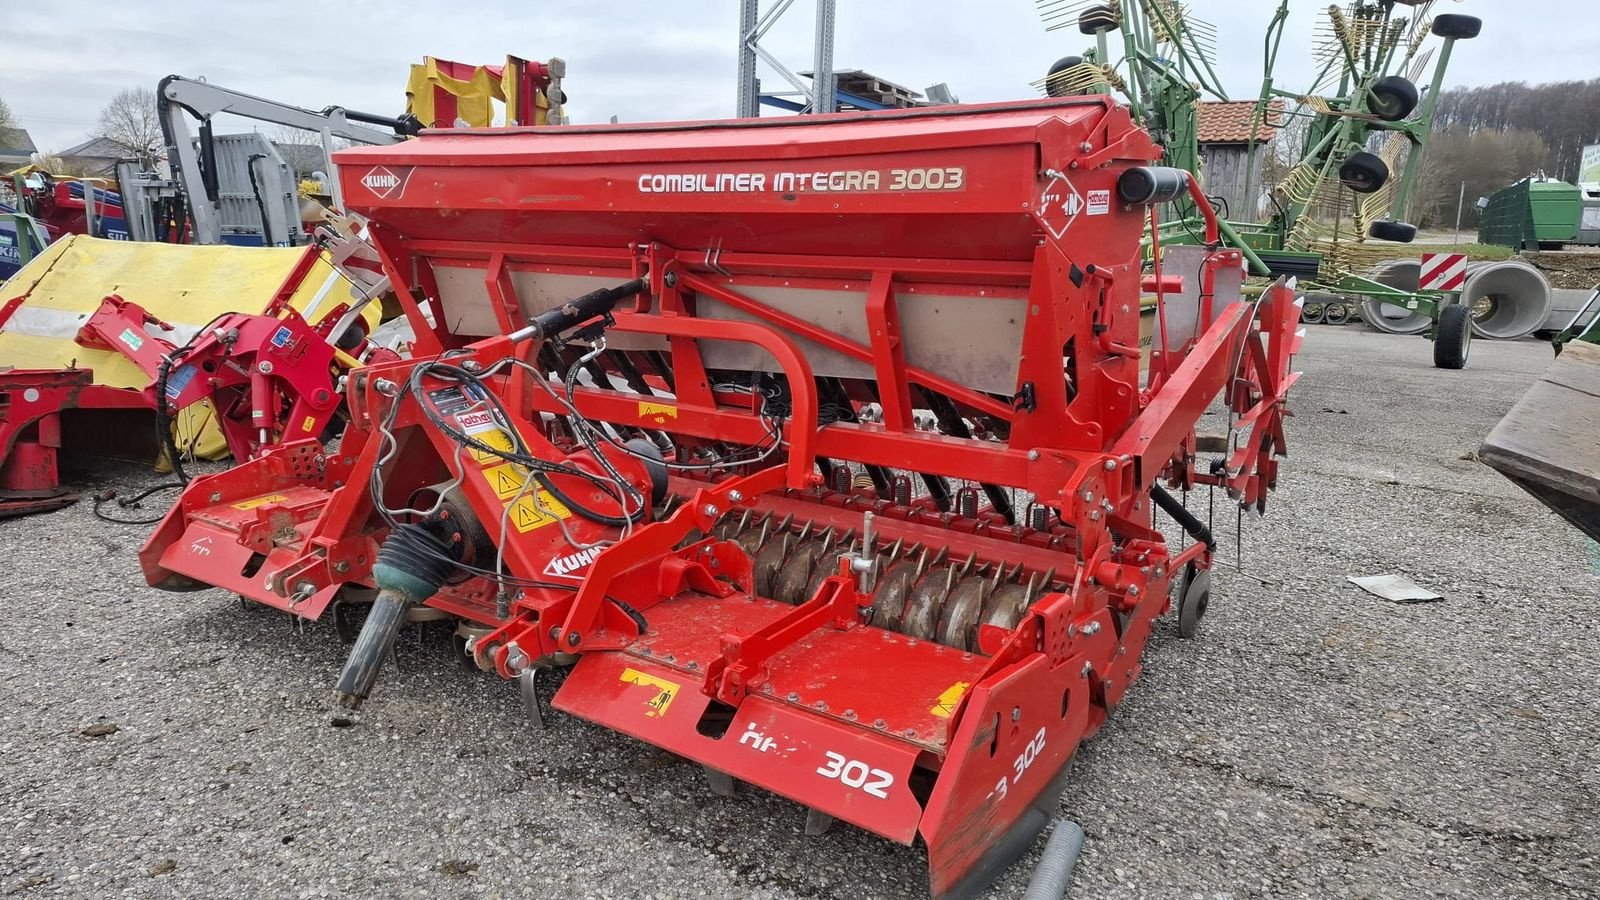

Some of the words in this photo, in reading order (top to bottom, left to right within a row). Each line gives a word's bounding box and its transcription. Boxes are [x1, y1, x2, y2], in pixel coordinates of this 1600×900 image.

[366, 175, 395, 188] KUHN
[638, 172, 766, 193] COMBILINER
[773, 170, 880, 192] INTEGRA
[889, 167, 964, 190] 3003
[551, 545, 601, 576] KUHN
[1013, 726, 1046, 785] 302
[816, 750, 894, 800] 302
